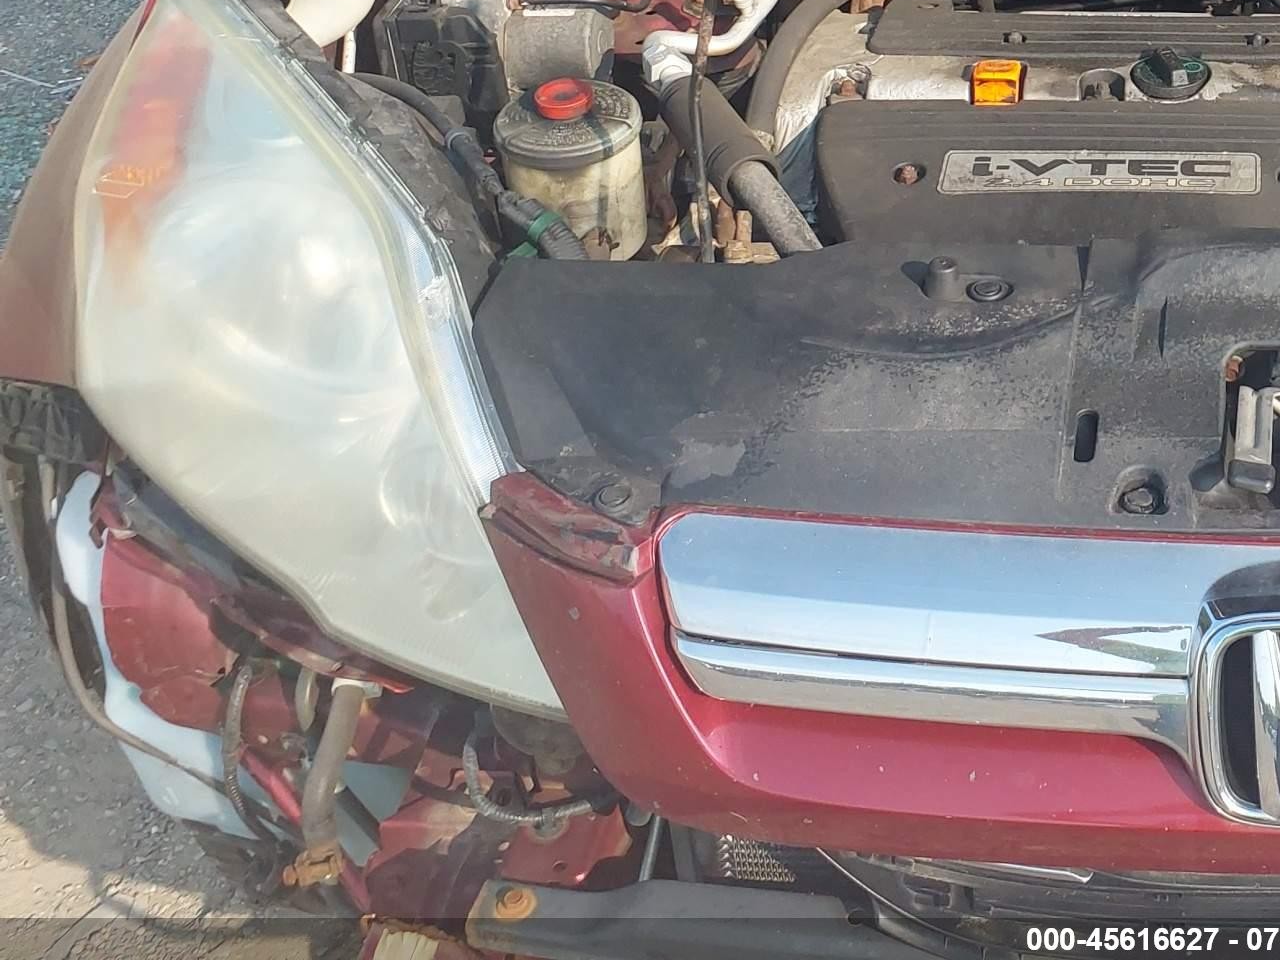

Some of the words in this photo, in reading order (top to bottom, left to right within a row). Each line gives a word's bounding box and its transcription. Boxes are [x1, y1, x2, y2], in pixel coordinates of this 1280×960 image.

[972, 156, 1231, 178] i-VTEC
[984, 178, 1053, 188] 2.4
[1064, 177, 1216, 188] DOHC
